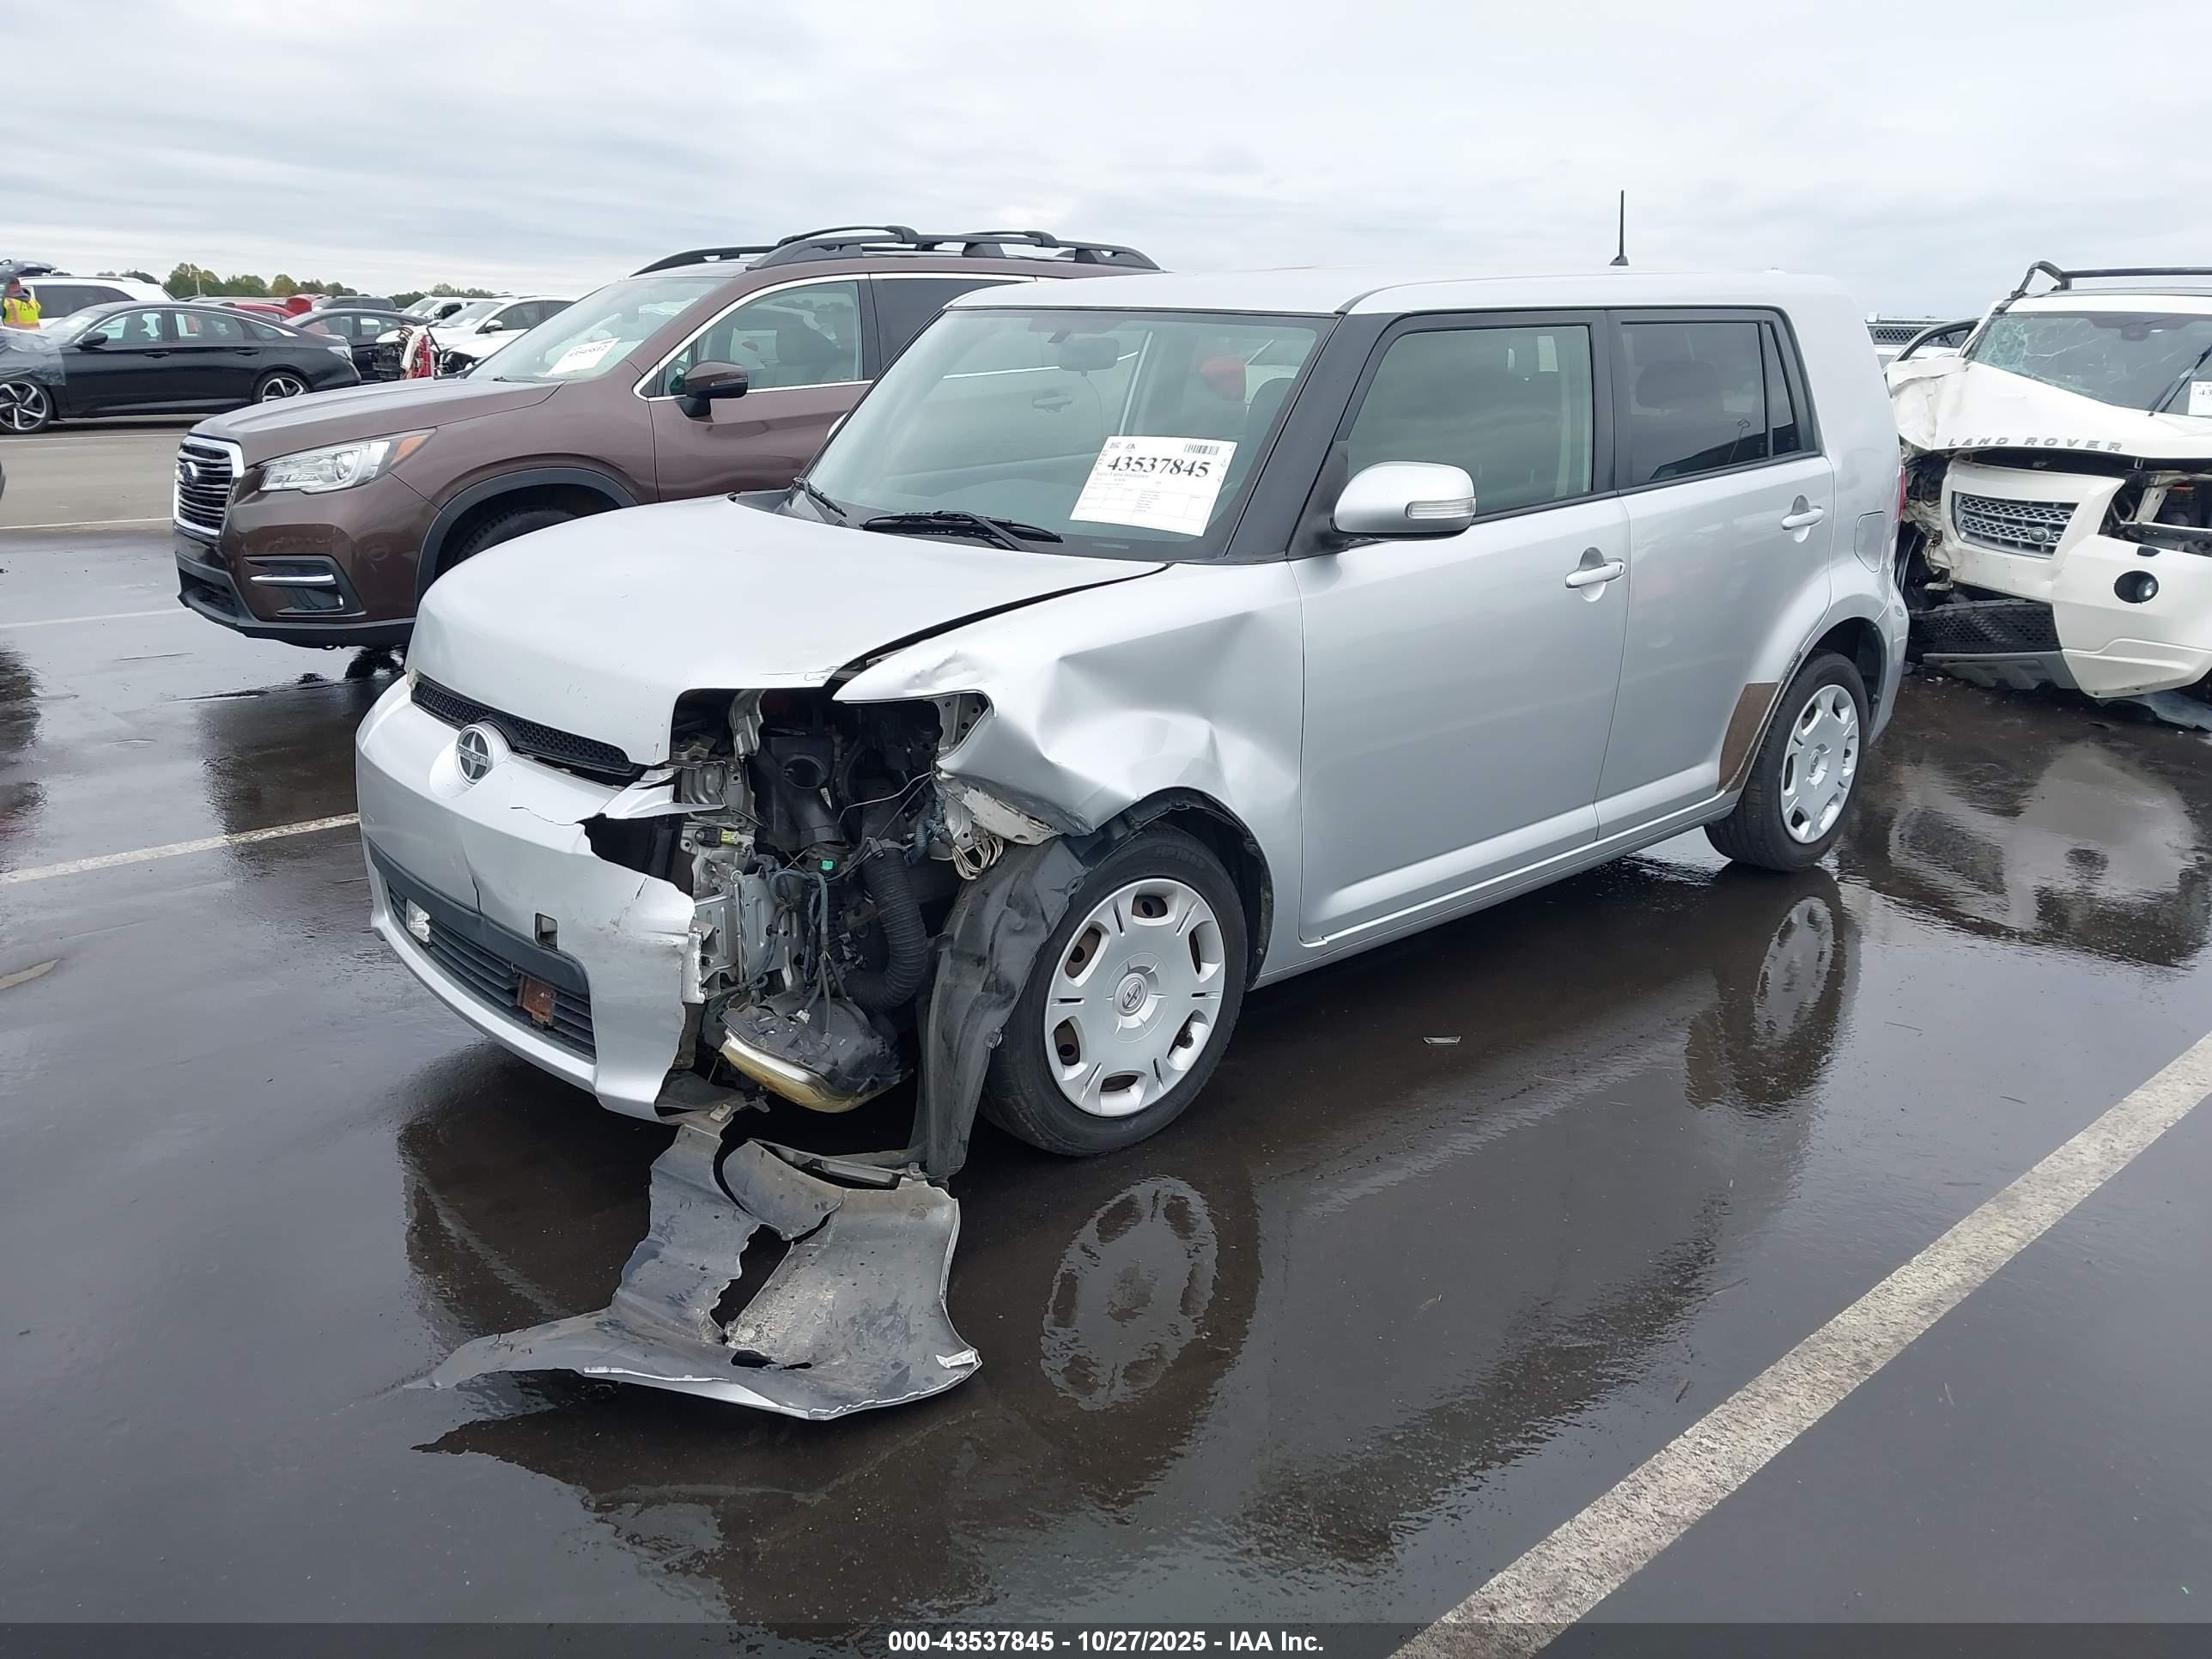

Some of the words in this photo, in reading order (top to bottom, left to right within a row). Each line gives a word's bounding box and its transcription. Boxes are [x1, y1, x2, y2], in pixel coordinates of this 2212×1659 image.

[1948, 436, 2009, 447] LAND
[2023, 436, 2123, 453] ROVER
[1107, 455, 1212, 478] 43537845
